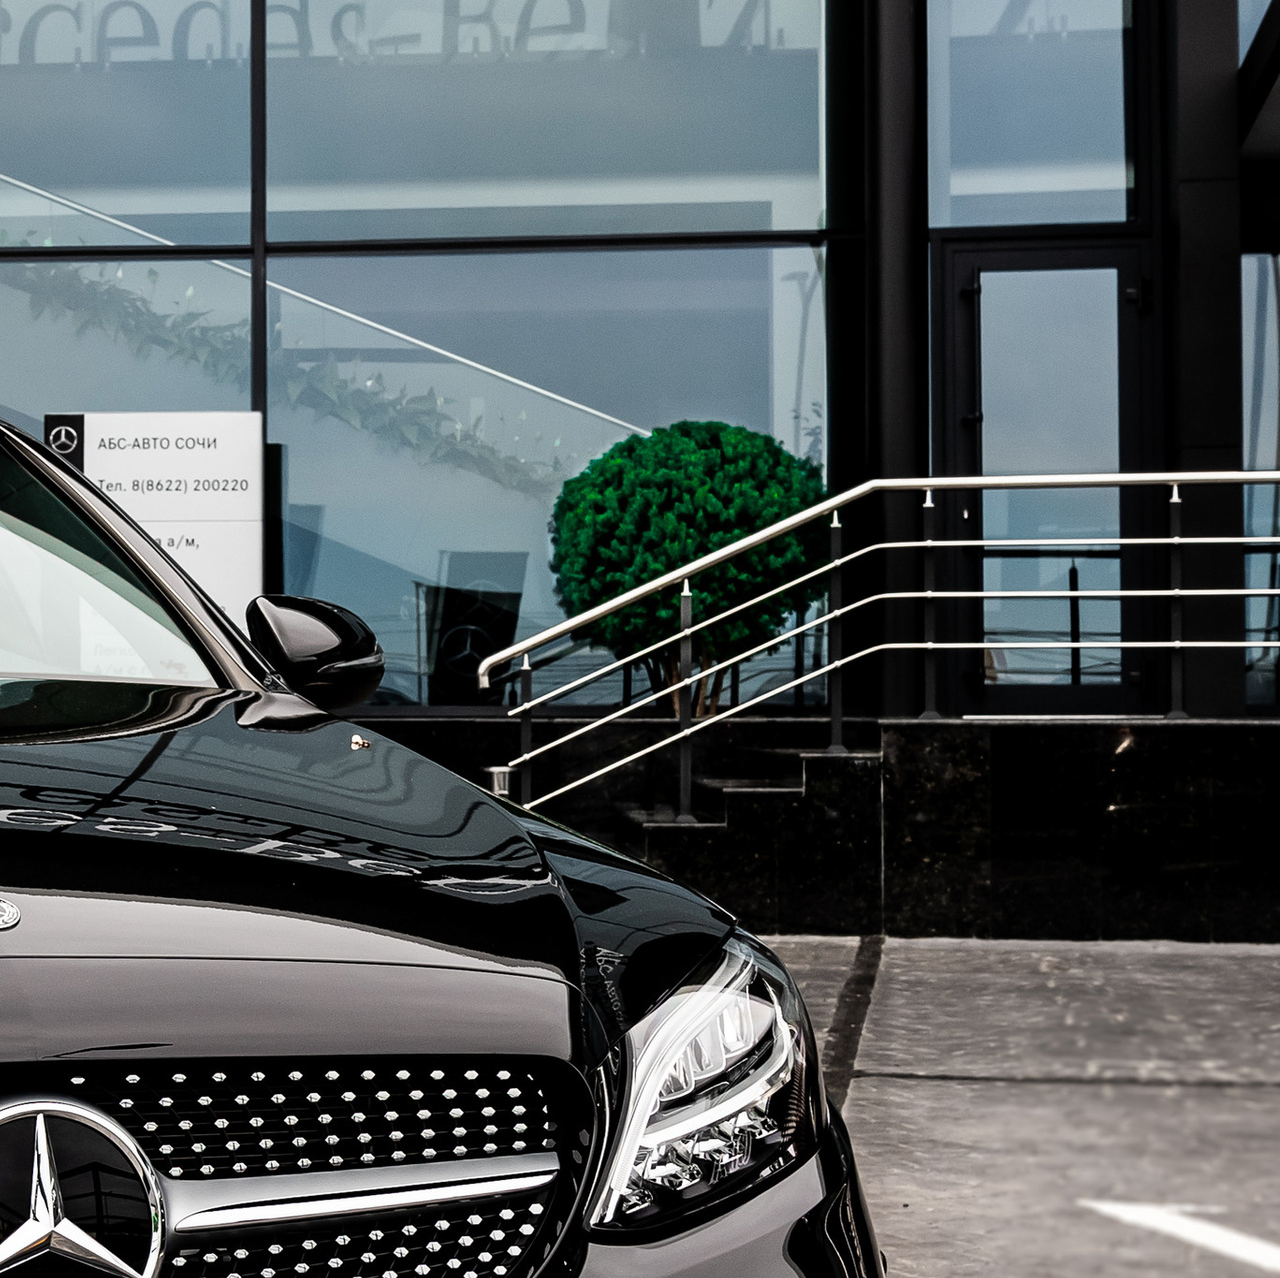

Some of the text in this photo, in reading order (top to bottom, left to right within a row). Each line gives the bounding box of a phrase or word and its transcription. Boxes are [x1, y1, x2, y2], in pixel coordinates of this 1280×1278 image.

[98, 437, 217, 450] АБС-АВТО СОЧИ
[98, 479, 249, 494] Тел. 8(8622) 200220
